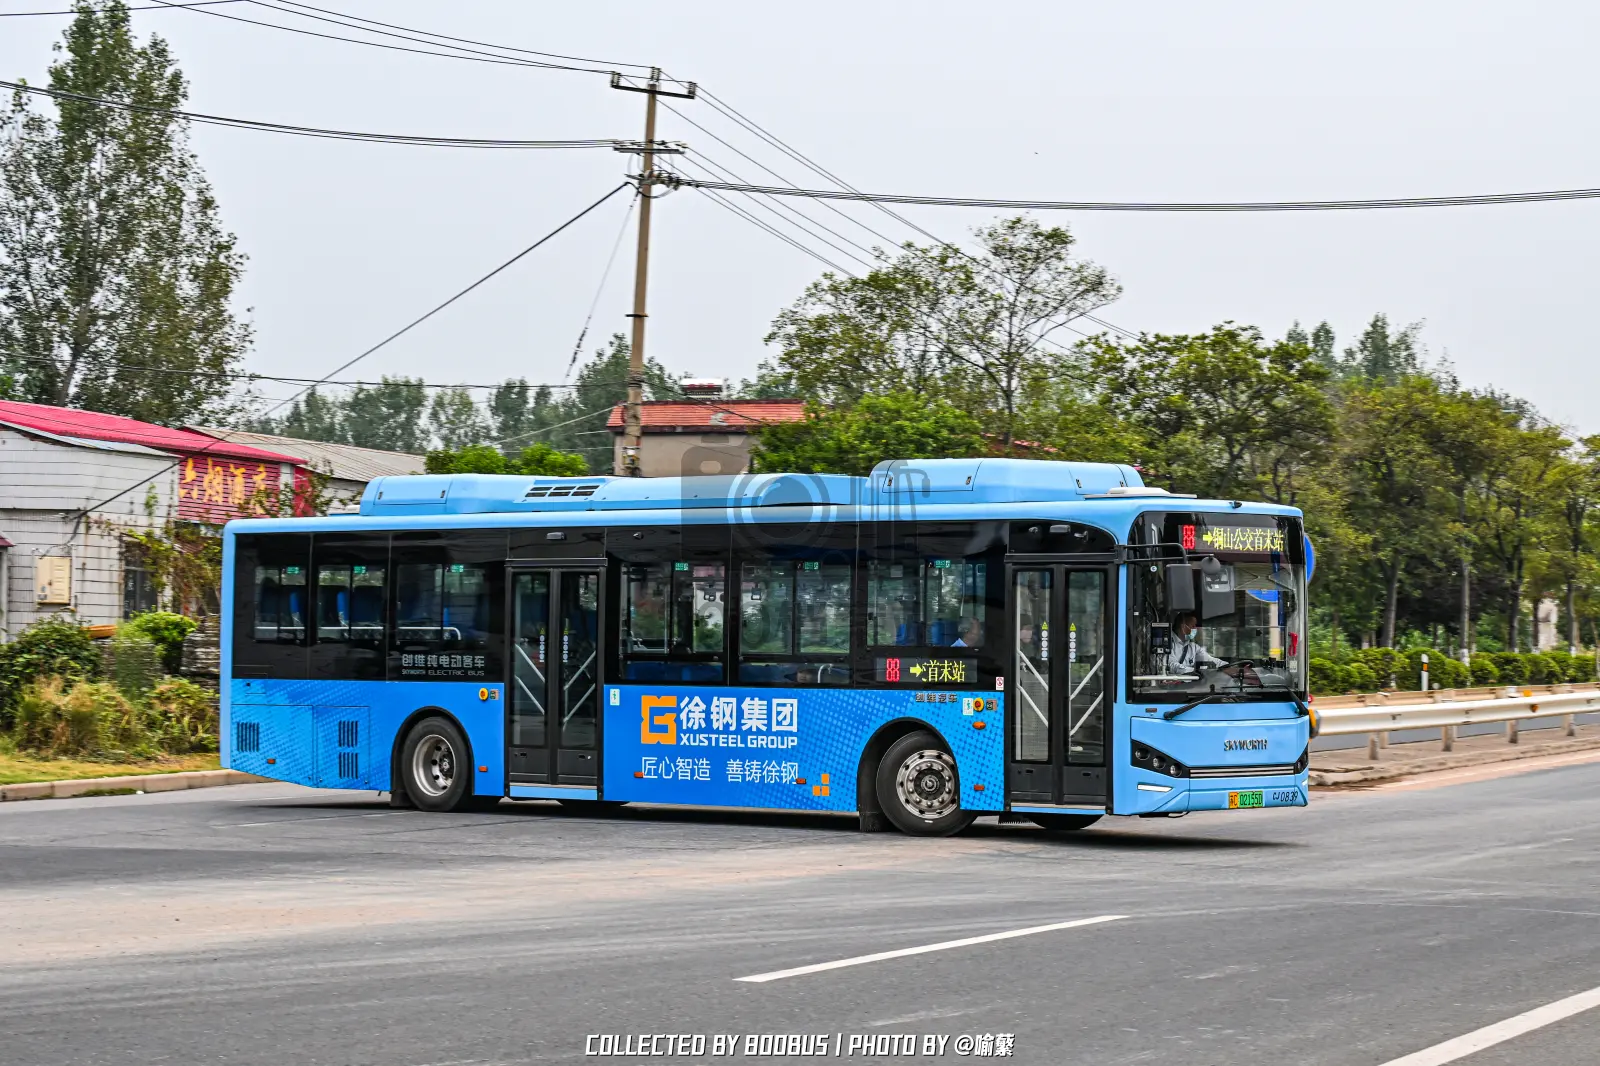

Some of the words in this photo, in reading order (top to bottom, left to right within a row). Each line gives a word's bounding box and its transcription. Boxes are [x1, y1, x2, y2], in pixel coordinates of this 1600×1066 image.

[1213, 527, 1283, 552] 铜山公交首末站
[402, 654, 485, 668] 创维纯电动客车
[915, 692, 958, 703] 创维汽车
[679, 695, 798, 732] 徐钢集团
[679, 733, 745, 748] XUSTEEL
[747, 735, 798, 749] GROUP
[1224, 739, 1268, 751] SKYWORTH
[641, 756, 711, 782] 匠心智造
[726, 758, 799, 785] 善铸徐钢
